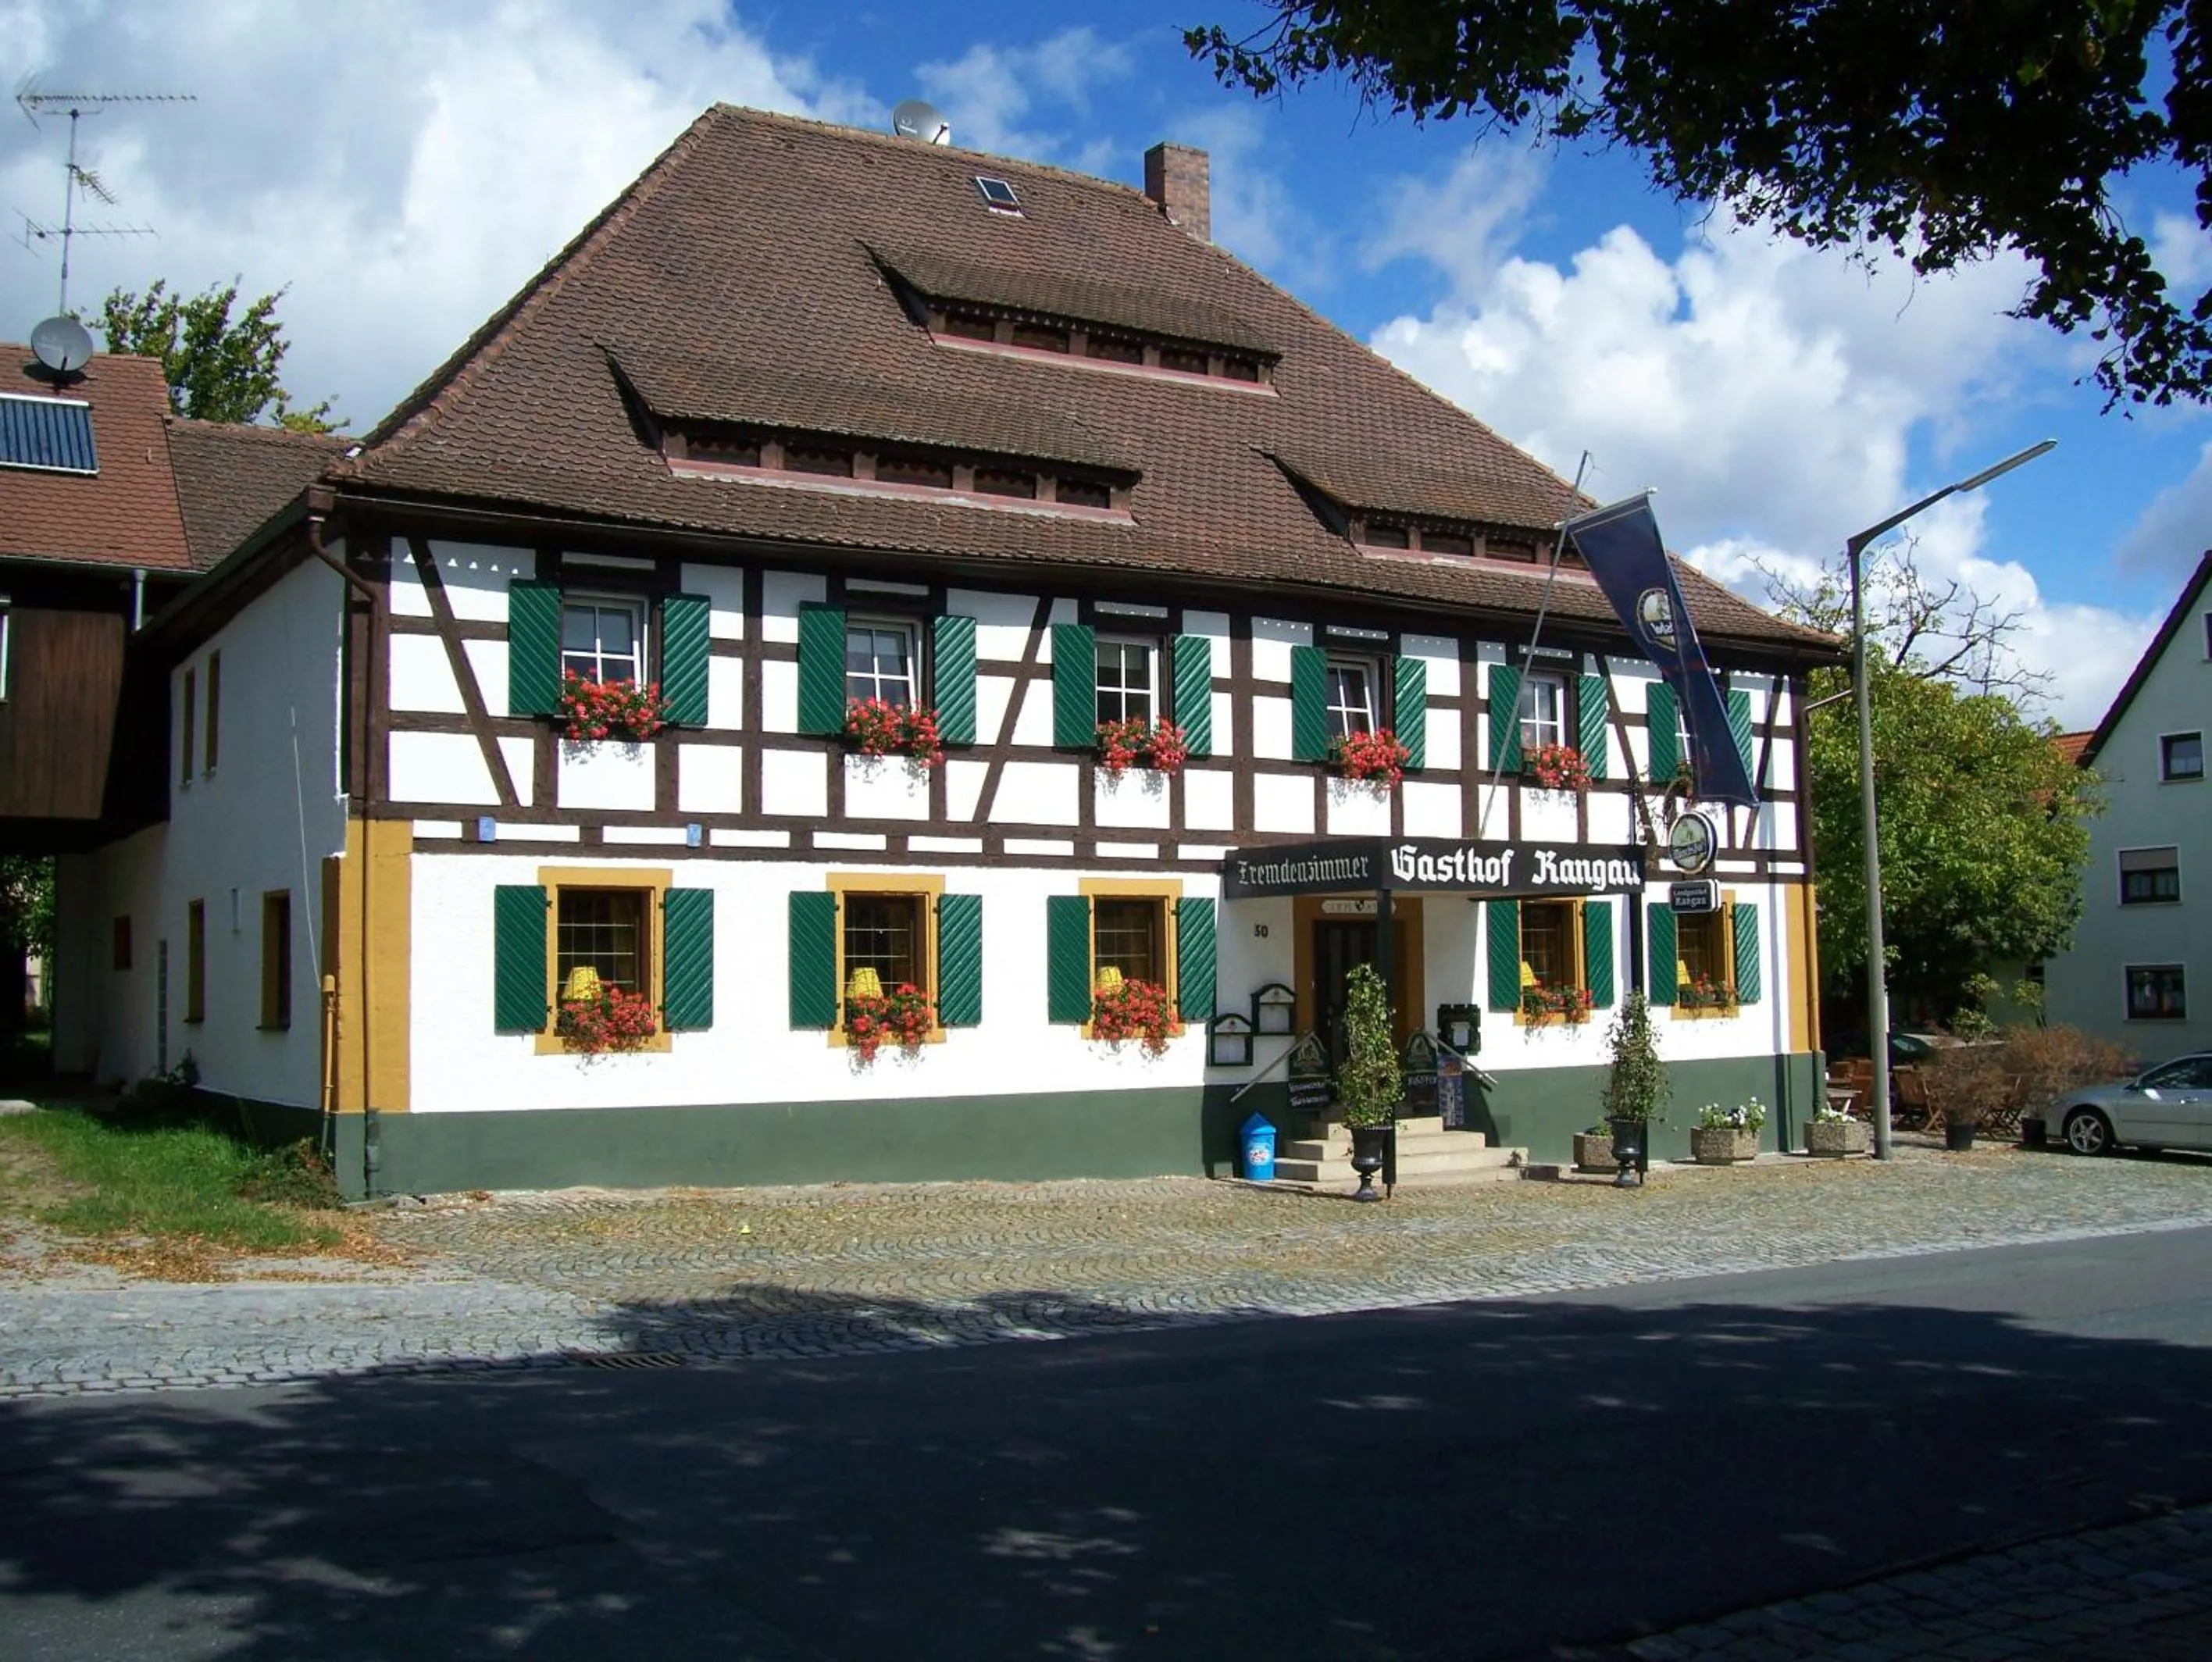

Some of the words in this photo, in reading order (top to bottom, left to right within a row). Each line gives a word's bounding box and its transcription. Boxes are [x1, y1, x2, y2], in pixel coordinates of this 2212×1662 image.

[1237, 854, 1369, 885] Fremdenzimmer
[1390, 844, 1515, 886] Gasthof
[1532, 849, 1641, 891] Rangau
[1254, 923, 1269, 938] 50
